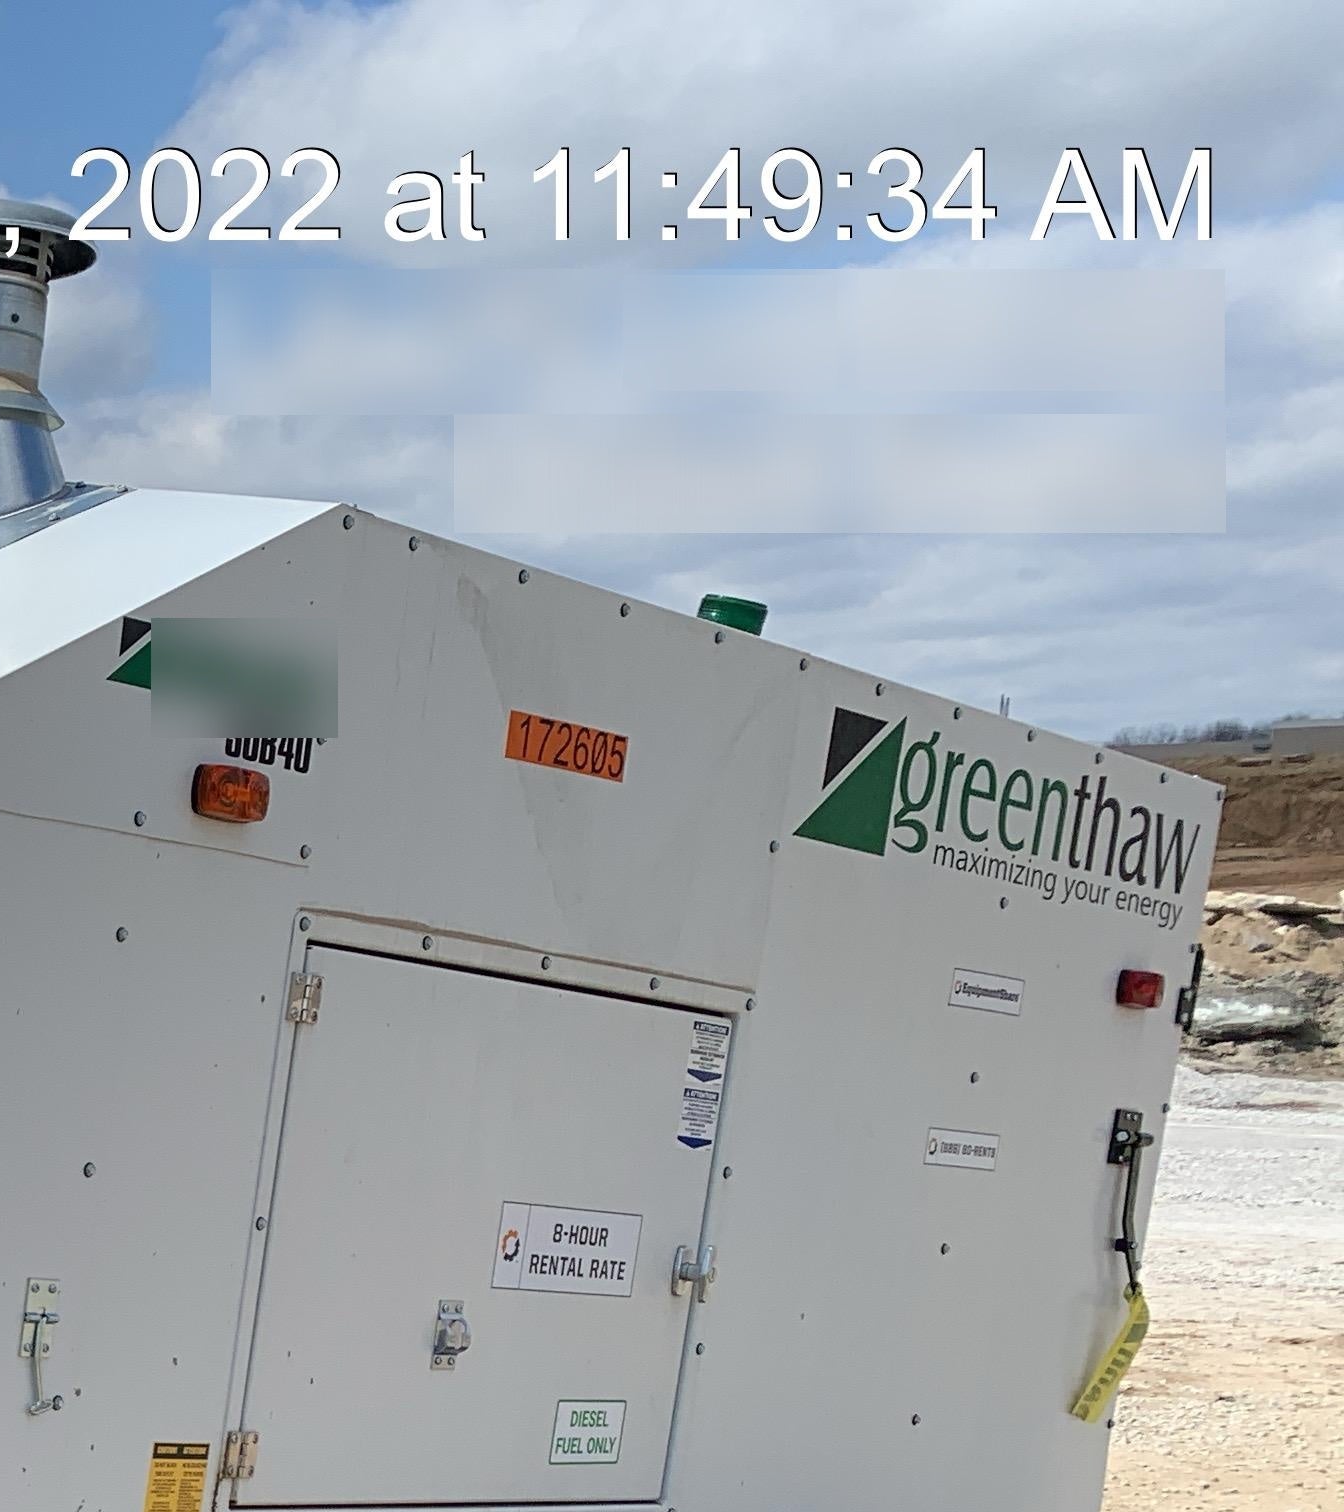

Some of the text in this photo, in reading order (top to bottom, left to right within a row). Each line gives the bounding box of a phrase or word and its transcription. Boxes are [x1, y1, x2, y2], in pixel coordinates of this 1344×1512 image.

[520, 715, 626, 778] 172605
[892, 731, 1200, 895] greenthaw
[932, 842, 1183, 931] maximizing your energy
[552, 1223, 609, 1248] 8-HOUR
[528, 1254, 627, 1281] RENTAL RATE
[569, 1410, 609, 1427] DIESEL
[554, 1436, 617, 1455] FUEL ONLY
